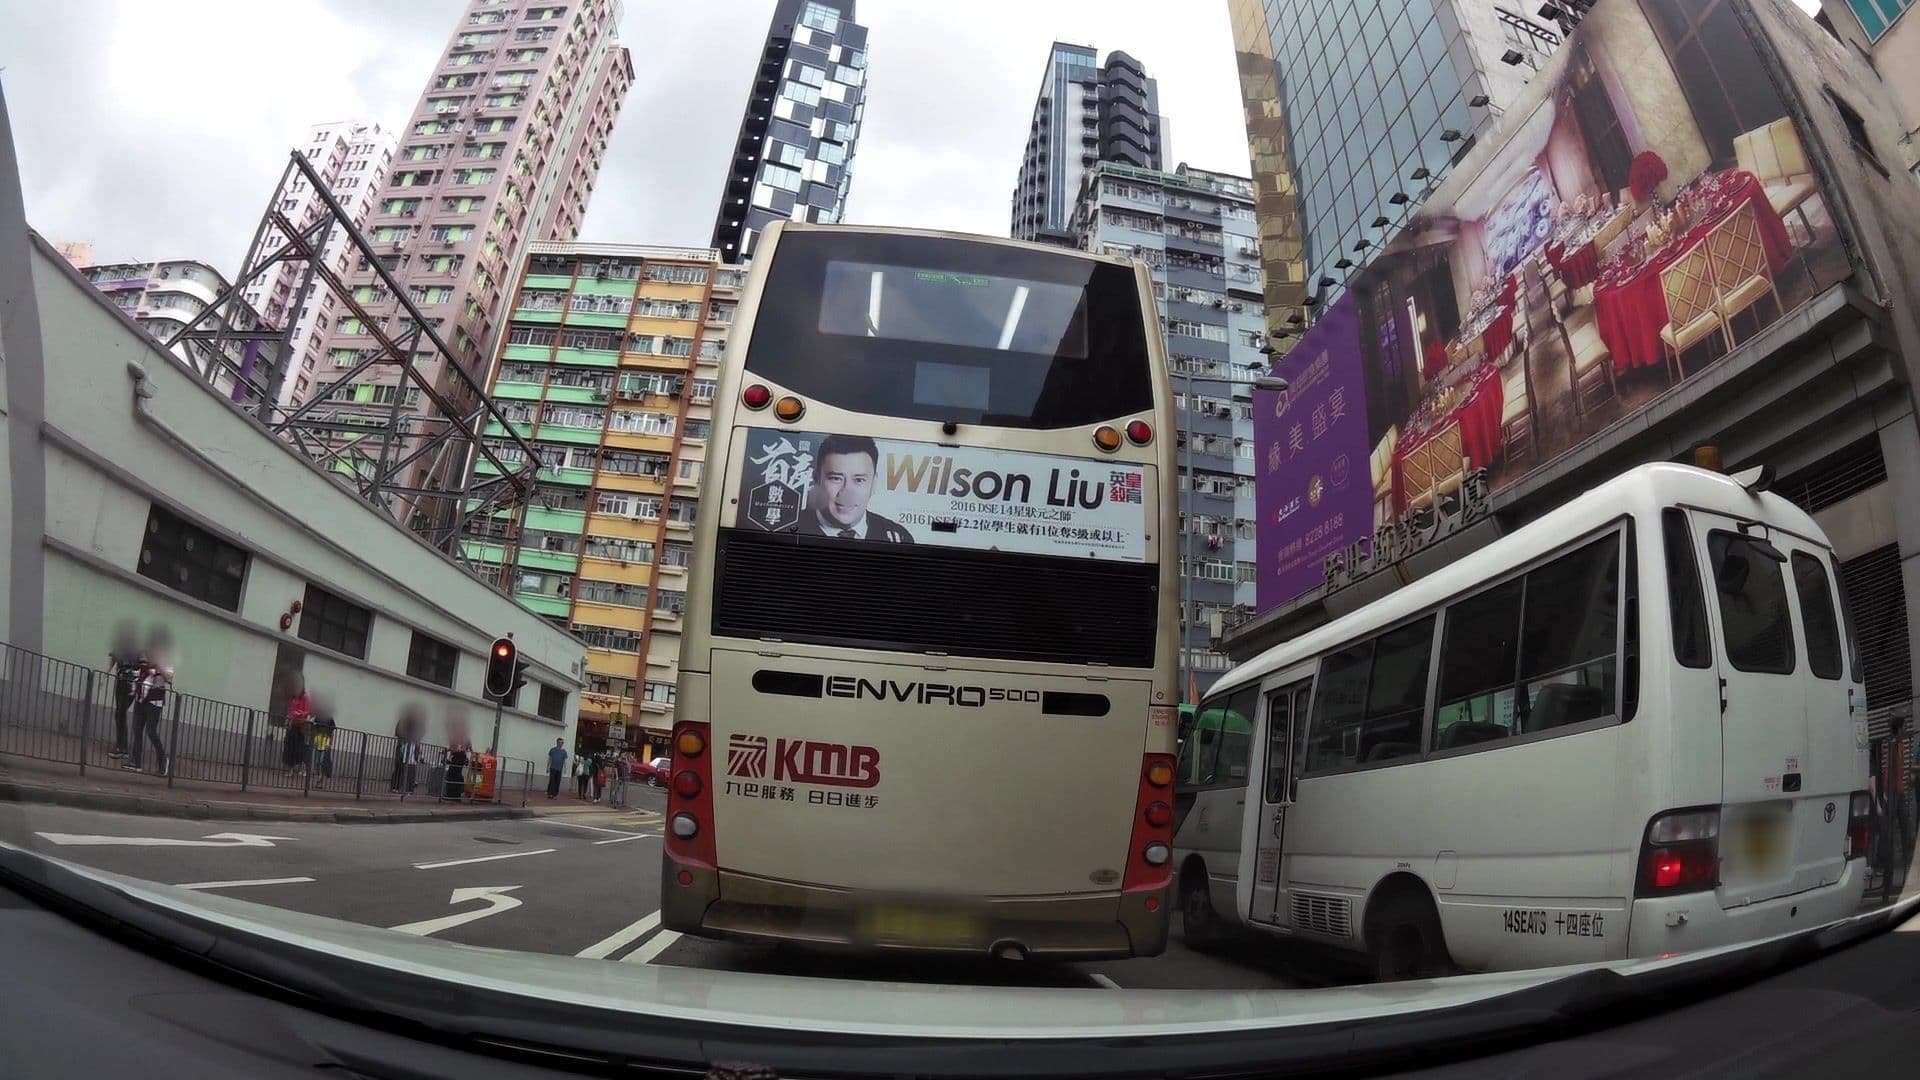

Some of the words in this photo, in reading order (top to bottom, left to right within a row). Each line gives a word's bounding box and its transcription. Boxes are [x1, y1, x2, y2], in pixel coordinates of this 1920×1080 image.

[886, 453, 1032, 503] Wilson
[1047, 468, 1105, 510] Liu
[899, 513, 926, 525] 2016
[950, 500, 976, 513] 2016
[978, 503, 999, 514] DSE
[774, 738, 881, 788] KMB
[726, 781, 796, 802] 九巴服務
[808, 790, 879, 809] 日日進步
[1554, 911, 1604, 938] 十四座位
